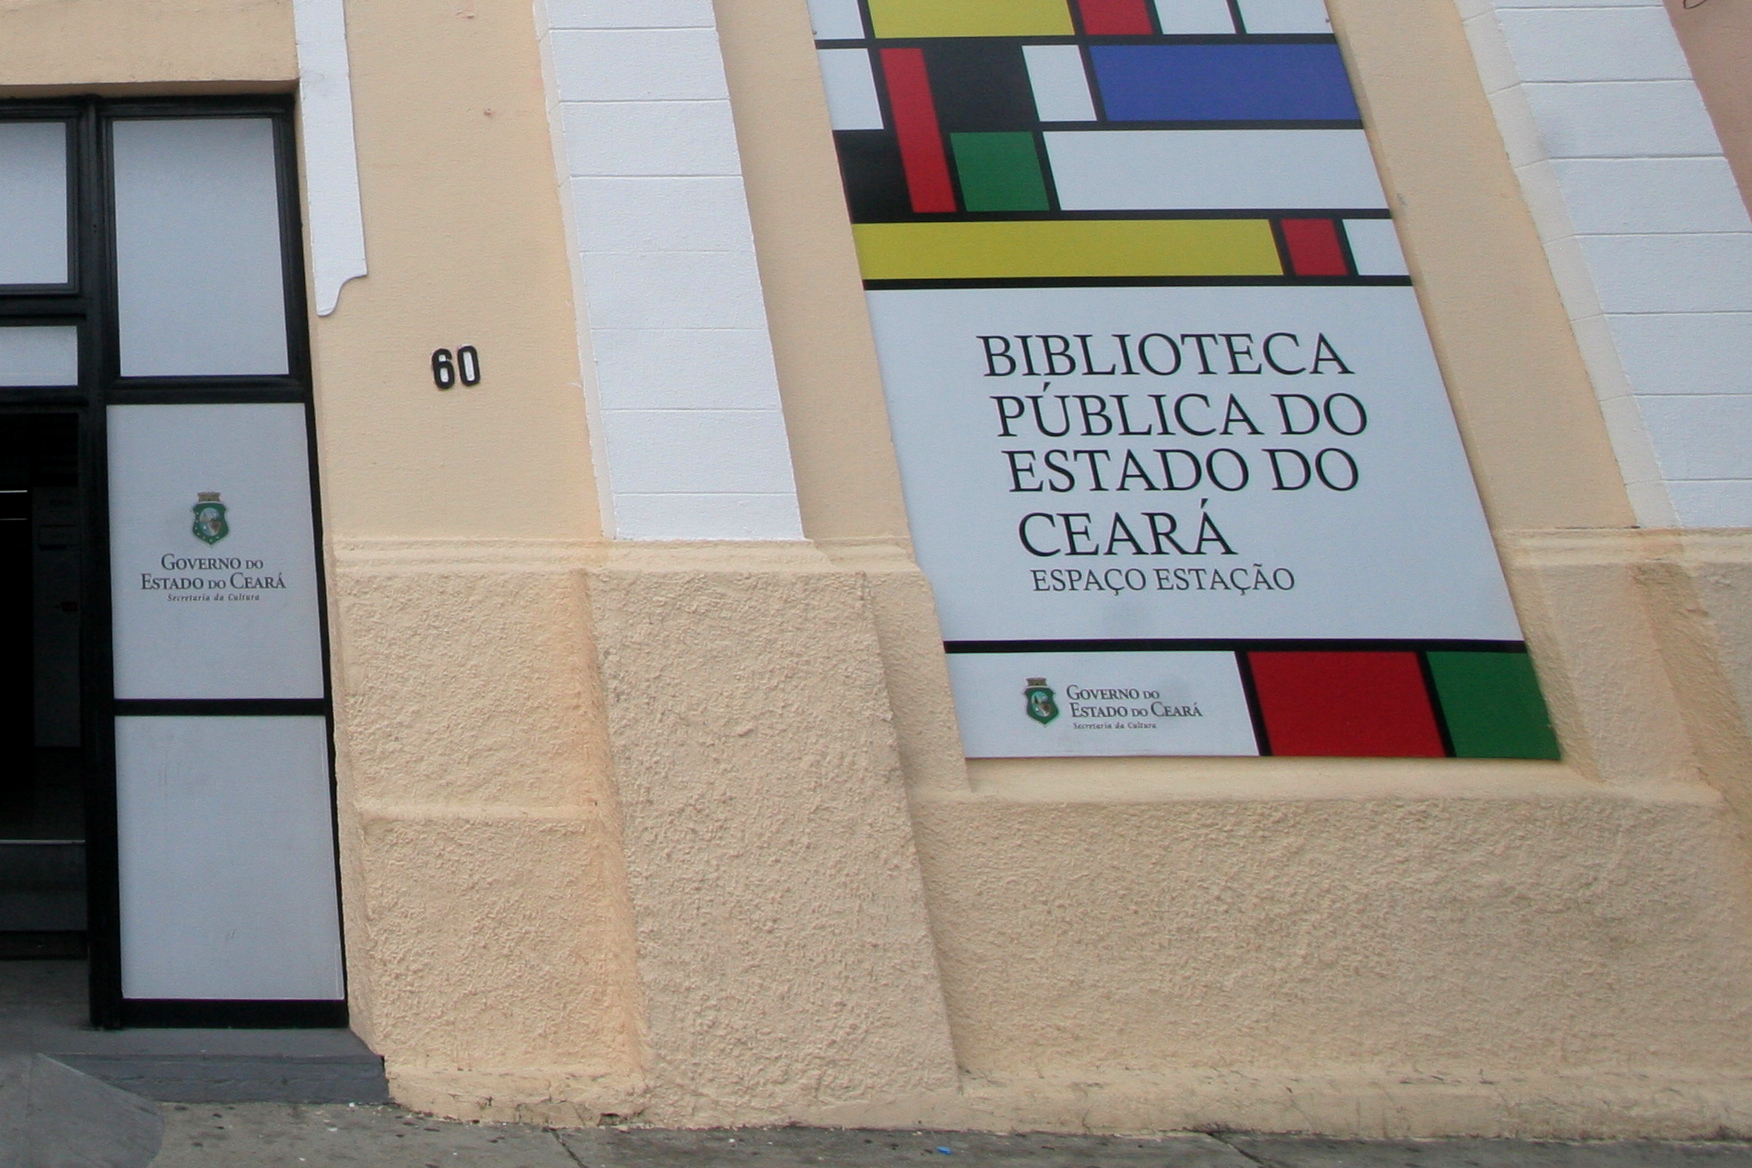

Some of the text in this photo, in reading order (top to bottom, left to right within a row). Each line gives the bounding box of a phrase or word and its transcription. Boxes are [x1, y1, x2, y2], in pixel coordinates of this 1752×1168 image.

[431, 344, 481, 390] 60
[975, 331, 1356, 377] BIBLIOTECA
[989, 381, 1369, 438] PÚBLICA DO
[1000, 447, 1360, 493] ESTADO DO
[1017, 497, 1239, 558] CEARÁ
[161, 553, 264, 571] GOVERNO DO
[140, 571, 286, 590] ESTADO DO CEARÁ
[1030, 563, 1295, 597] ESPAÇO ESTAÇÃO
[167, 593, 210, 602] Secretaria
[228, 593, 260, 602] Cultura
[1065, 684, 1160, 701] GOVERNO DO
[1069, 701, 1204, 718] ESTADO DO CEARÁ
